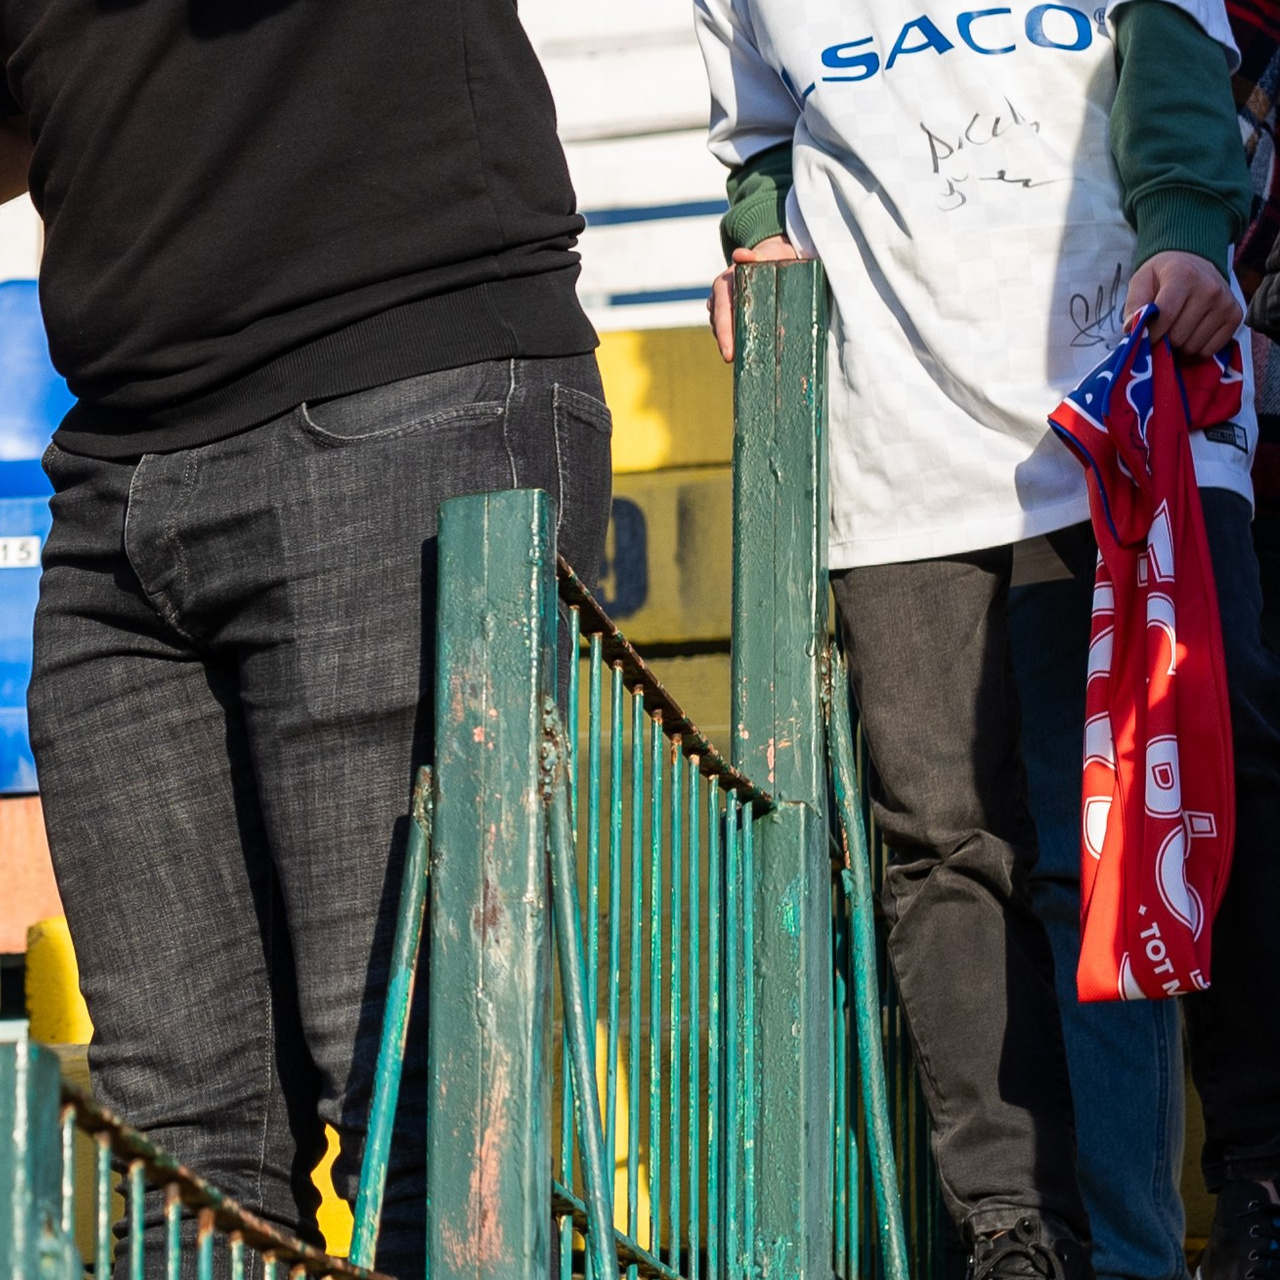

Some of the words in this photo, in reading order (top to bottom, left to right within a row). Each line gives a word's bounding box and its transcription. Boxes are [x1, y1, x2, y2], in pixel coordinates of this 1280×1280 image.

[780, 3, 1093, 112] LSACO
[0, 541, 33, 563] 15
[1139, 921, 1175, 975] TOT
